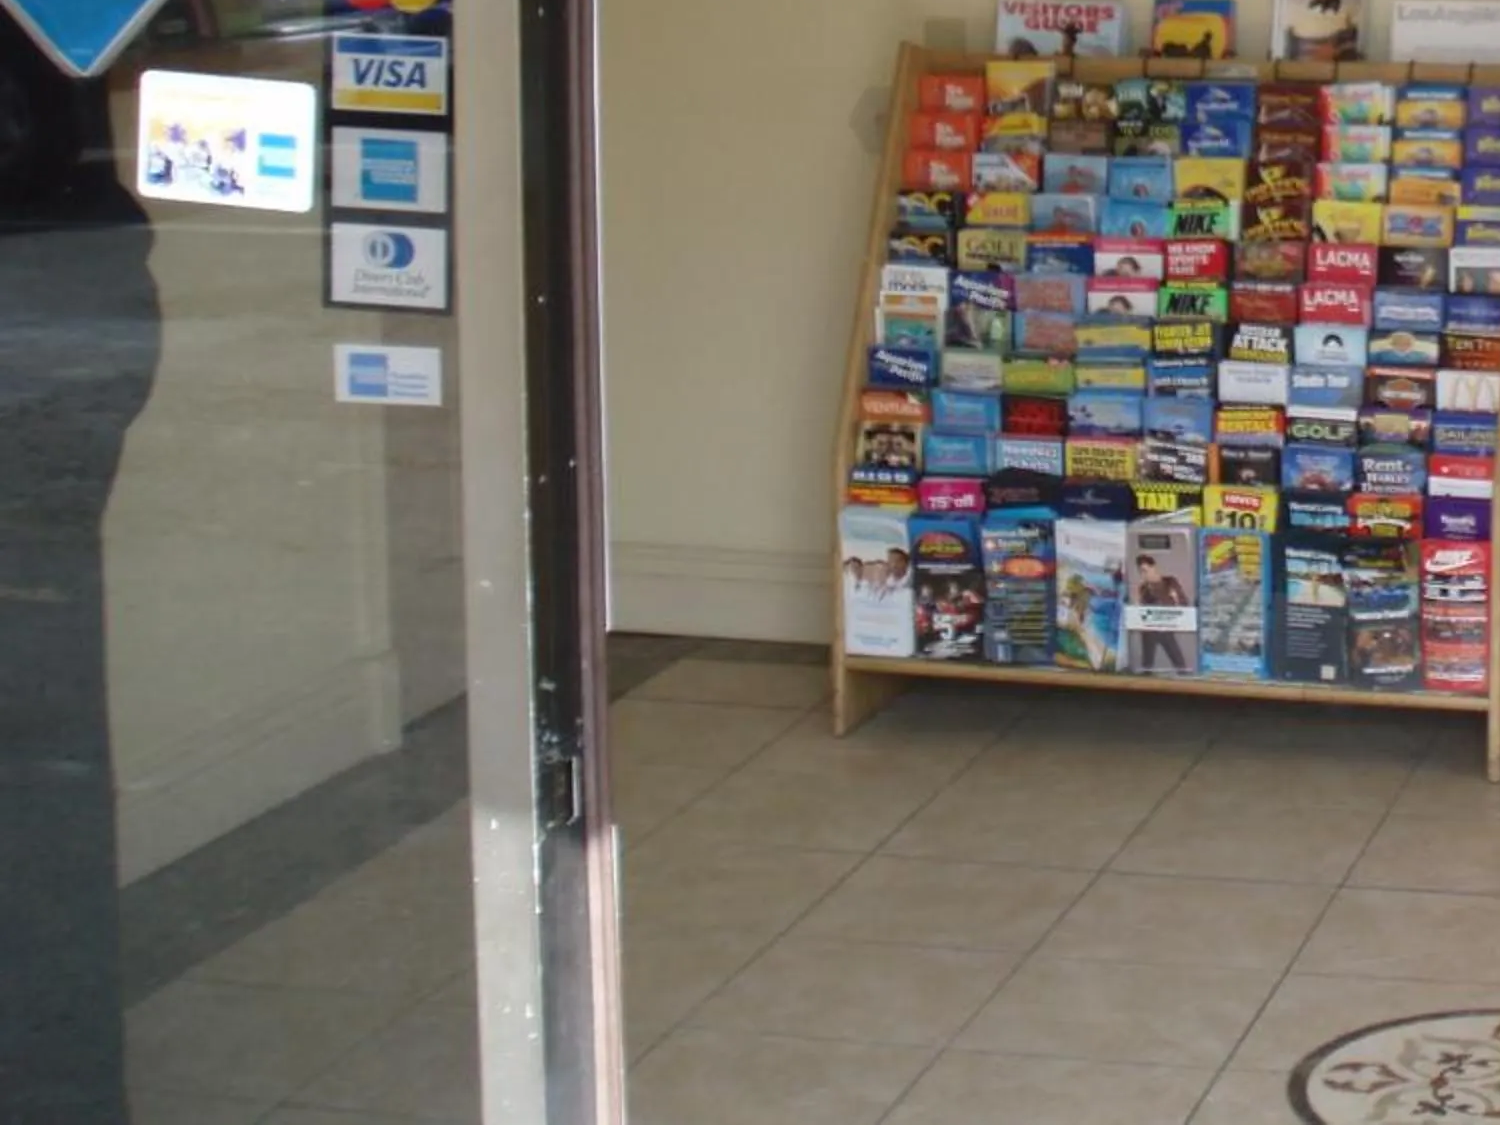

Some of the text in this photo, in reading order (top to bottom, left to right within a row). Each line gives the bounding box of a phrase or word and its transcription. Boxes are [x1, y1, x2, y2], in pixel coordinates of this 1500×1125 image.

[1003, 0, 1115, 21] VISITORS
[353, 58, 428, 90] VISA
[1174, 212, 1220, 235] NIKE
[1315, 250, 1372, 268] LACMA
[1167, 293, 1215, 314] NIKE
[1303, 289, 1359, 307] LACMA
[1233, 334, 1289, 354] ATTACK
[1290, 423, 1352, 441] GOLF
[1362, 458, 1404, 473] Rent
[1136, 491, 1177, 512] TAXI
